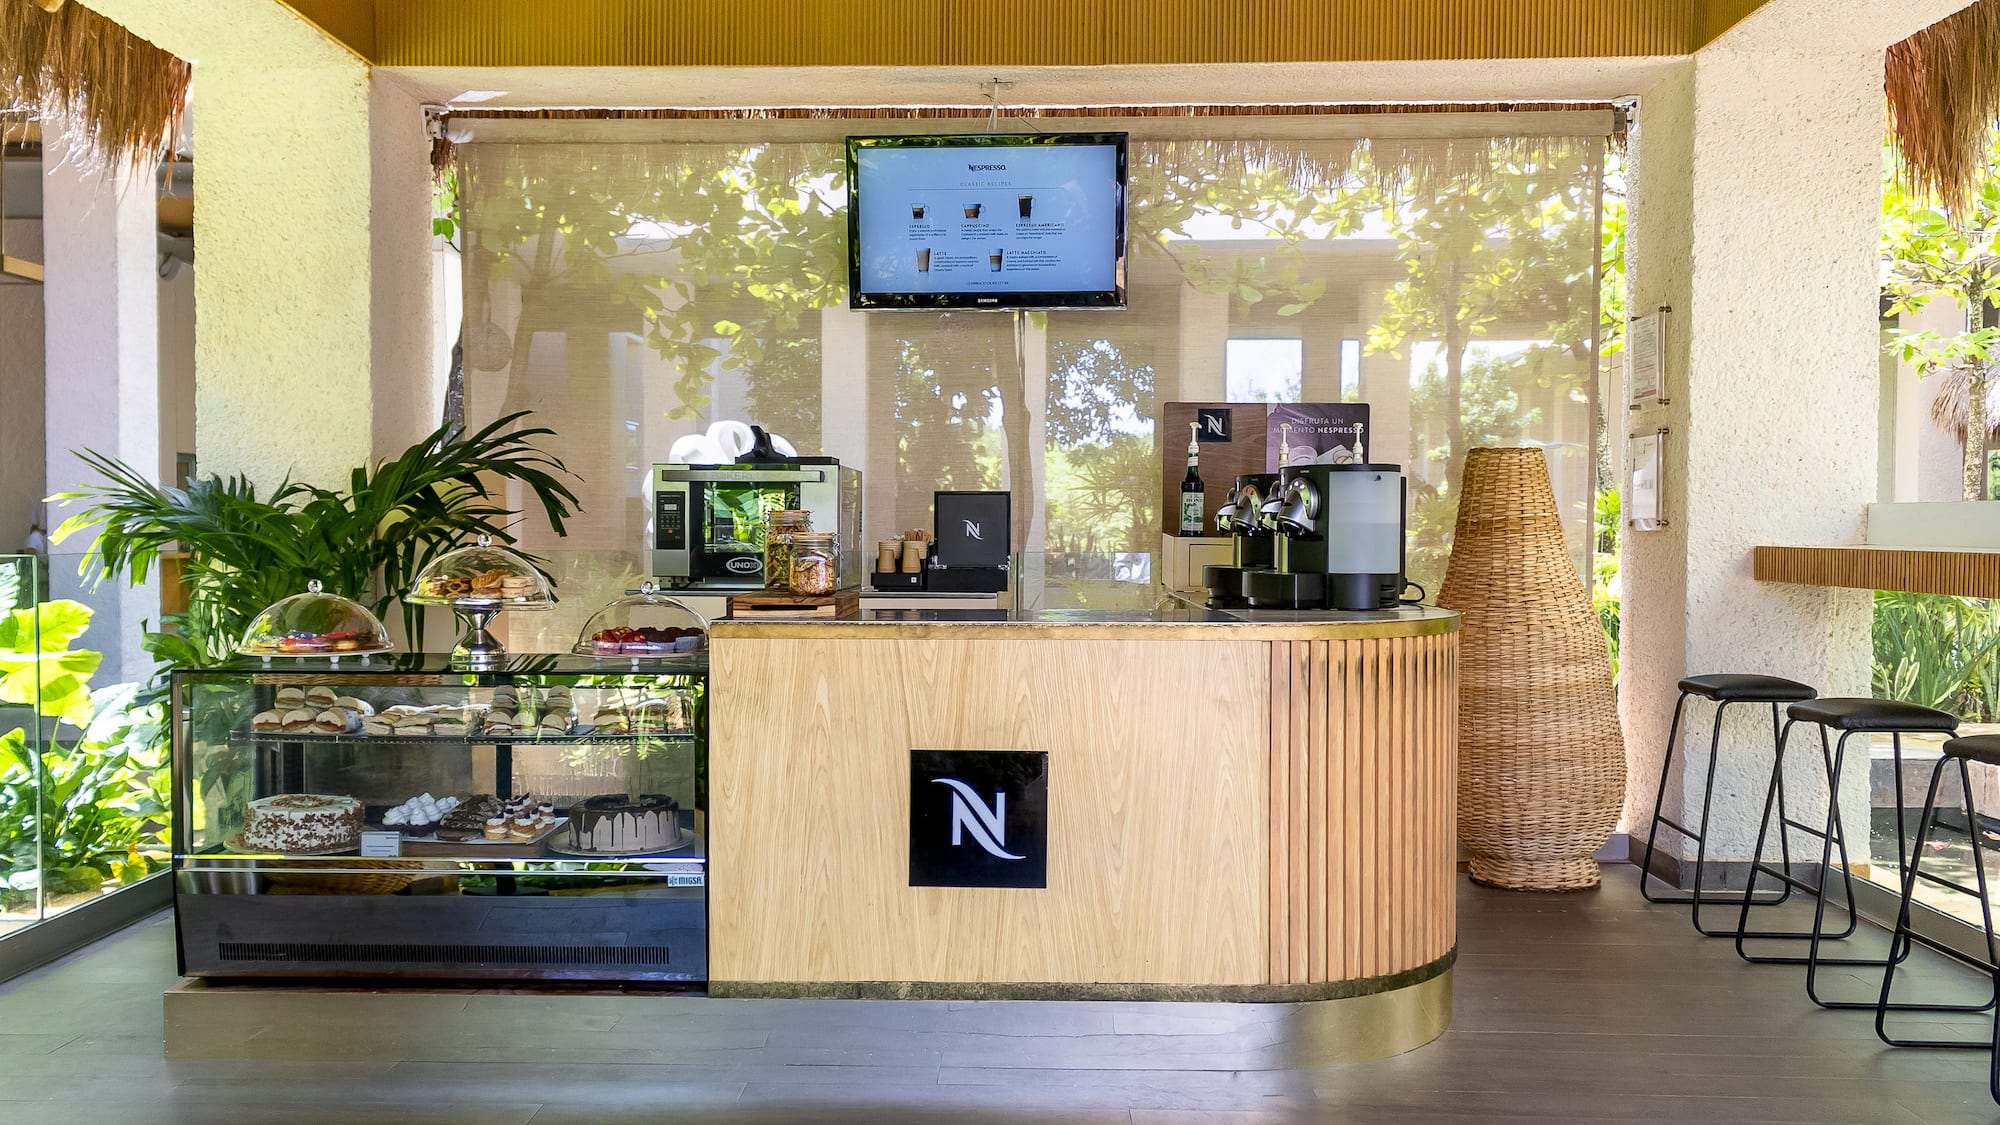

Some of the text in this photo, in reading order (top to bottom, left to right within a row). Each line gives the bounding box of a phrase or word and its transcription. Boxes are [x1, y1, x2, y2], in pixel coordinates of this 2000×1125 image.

[967, 163, 1006, 172] NESPRESSO
[1203, 414, 1227, 437] N
[1291, 417, 1330, 425] DISFRUTA
[961, 519, 985, 540] N
[931, 778, 1027, 860] N
